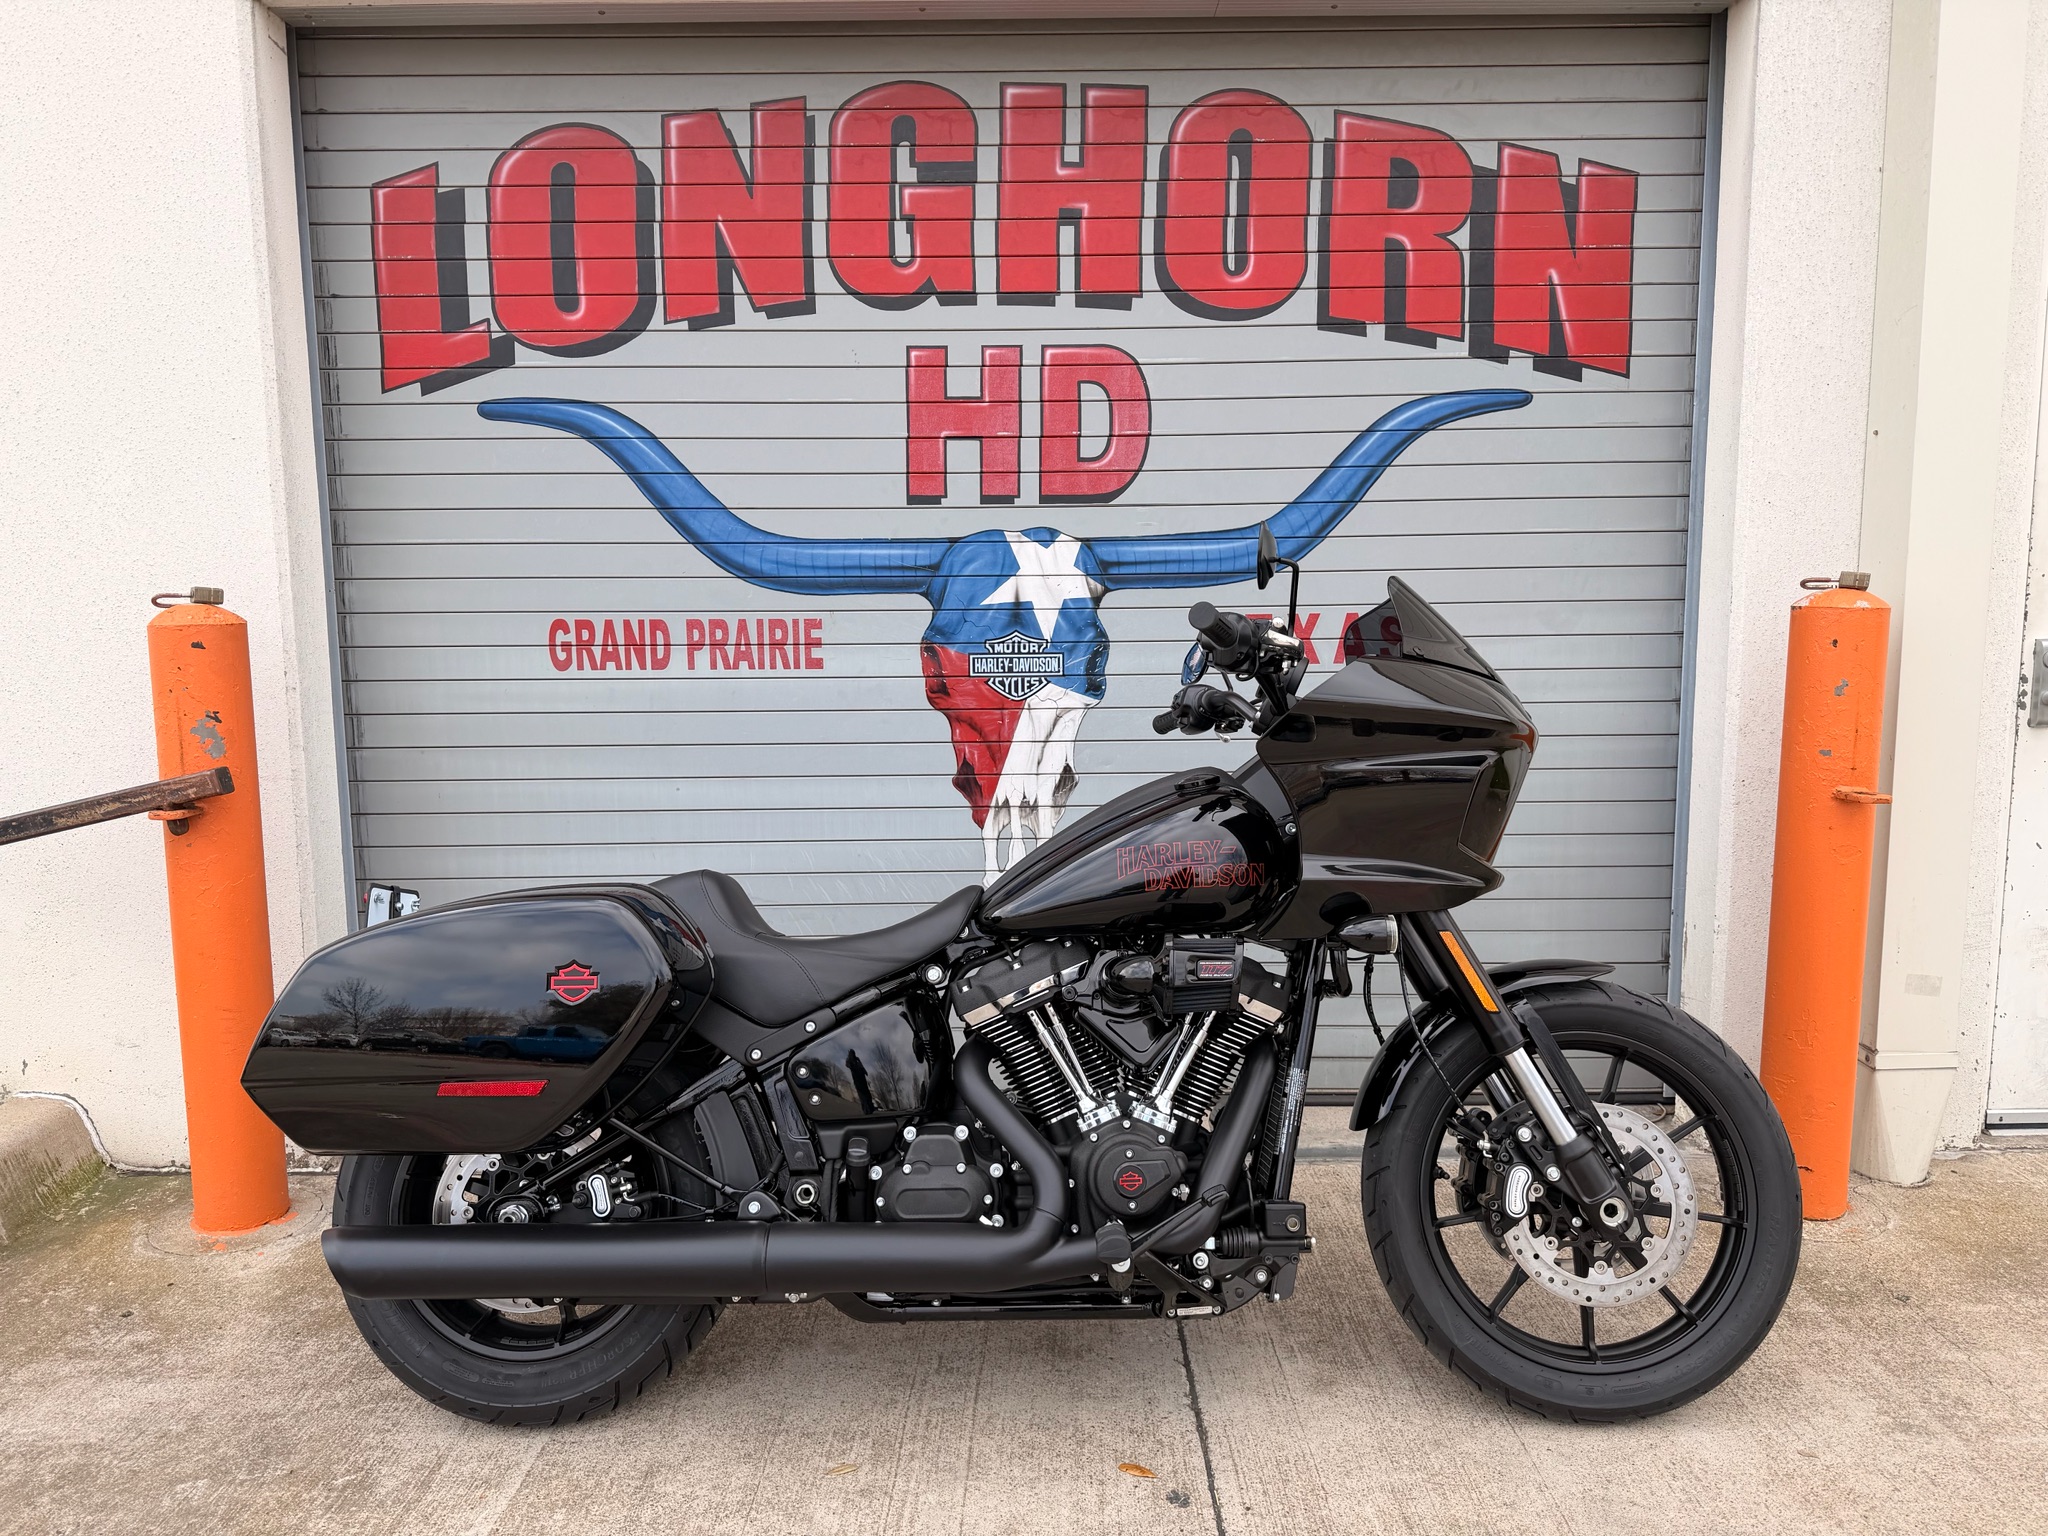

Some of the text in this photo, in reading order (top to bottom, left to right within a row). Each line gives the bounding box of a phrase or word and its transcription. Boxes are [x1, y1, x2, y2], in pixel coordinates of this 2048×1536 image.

[371, 80, 1640, 395] LONGHORN
[906, 344, 1152, 505] HD
[548, 618, 824, 672] GRAND PRAIRIE
[994, 637, 1039, 654] MOTOR
[974, 657, 1060, 673] HARLEY-DAVIDSON
[994, 677, 1041, 697] CYCLES
[1143, 863, 1265, 892] DAVIDSON
